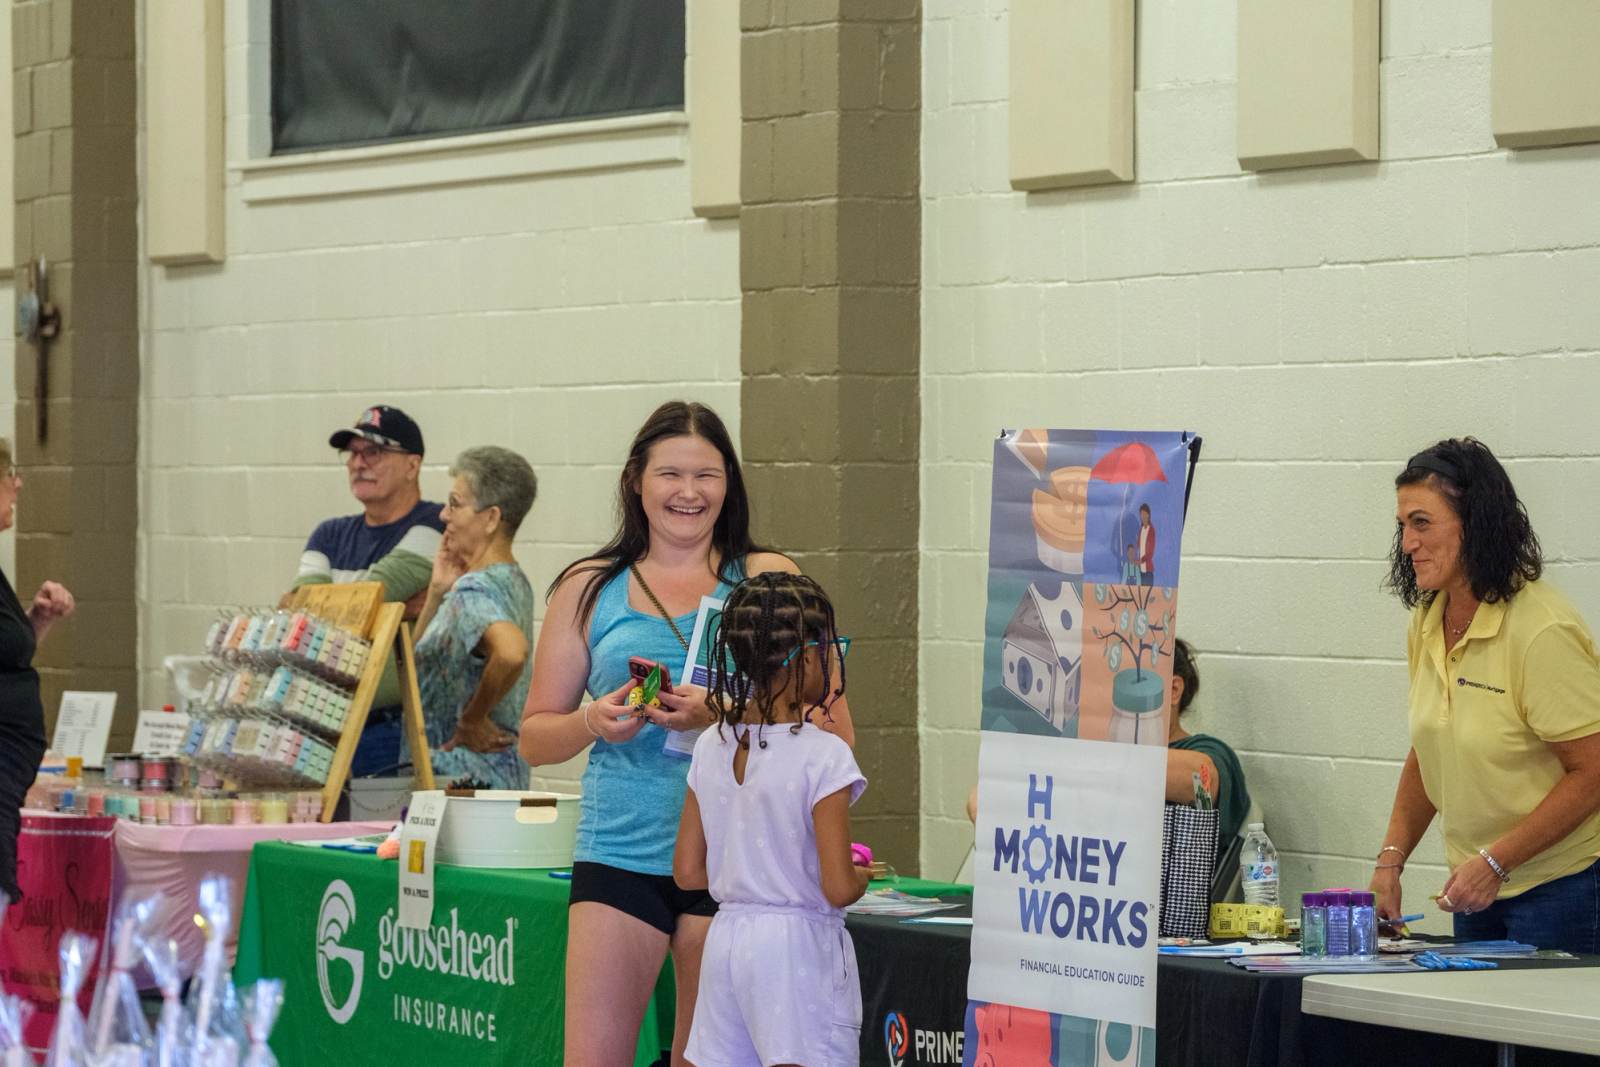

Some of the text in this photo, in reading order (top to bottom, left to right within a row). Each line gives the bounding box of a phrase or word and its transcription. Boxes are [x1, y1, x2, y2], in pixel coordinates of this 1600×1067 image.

[993, 823, 1127, 886] MONEY
[378, 908, 515, 986] goosehead
[1018, 887, 1149, 948] WORKS
[1020, 958, 1145, 988] FINANCIAL EDUCATION GUIDE
[394, 994, 496, 1042] INSURANCE
